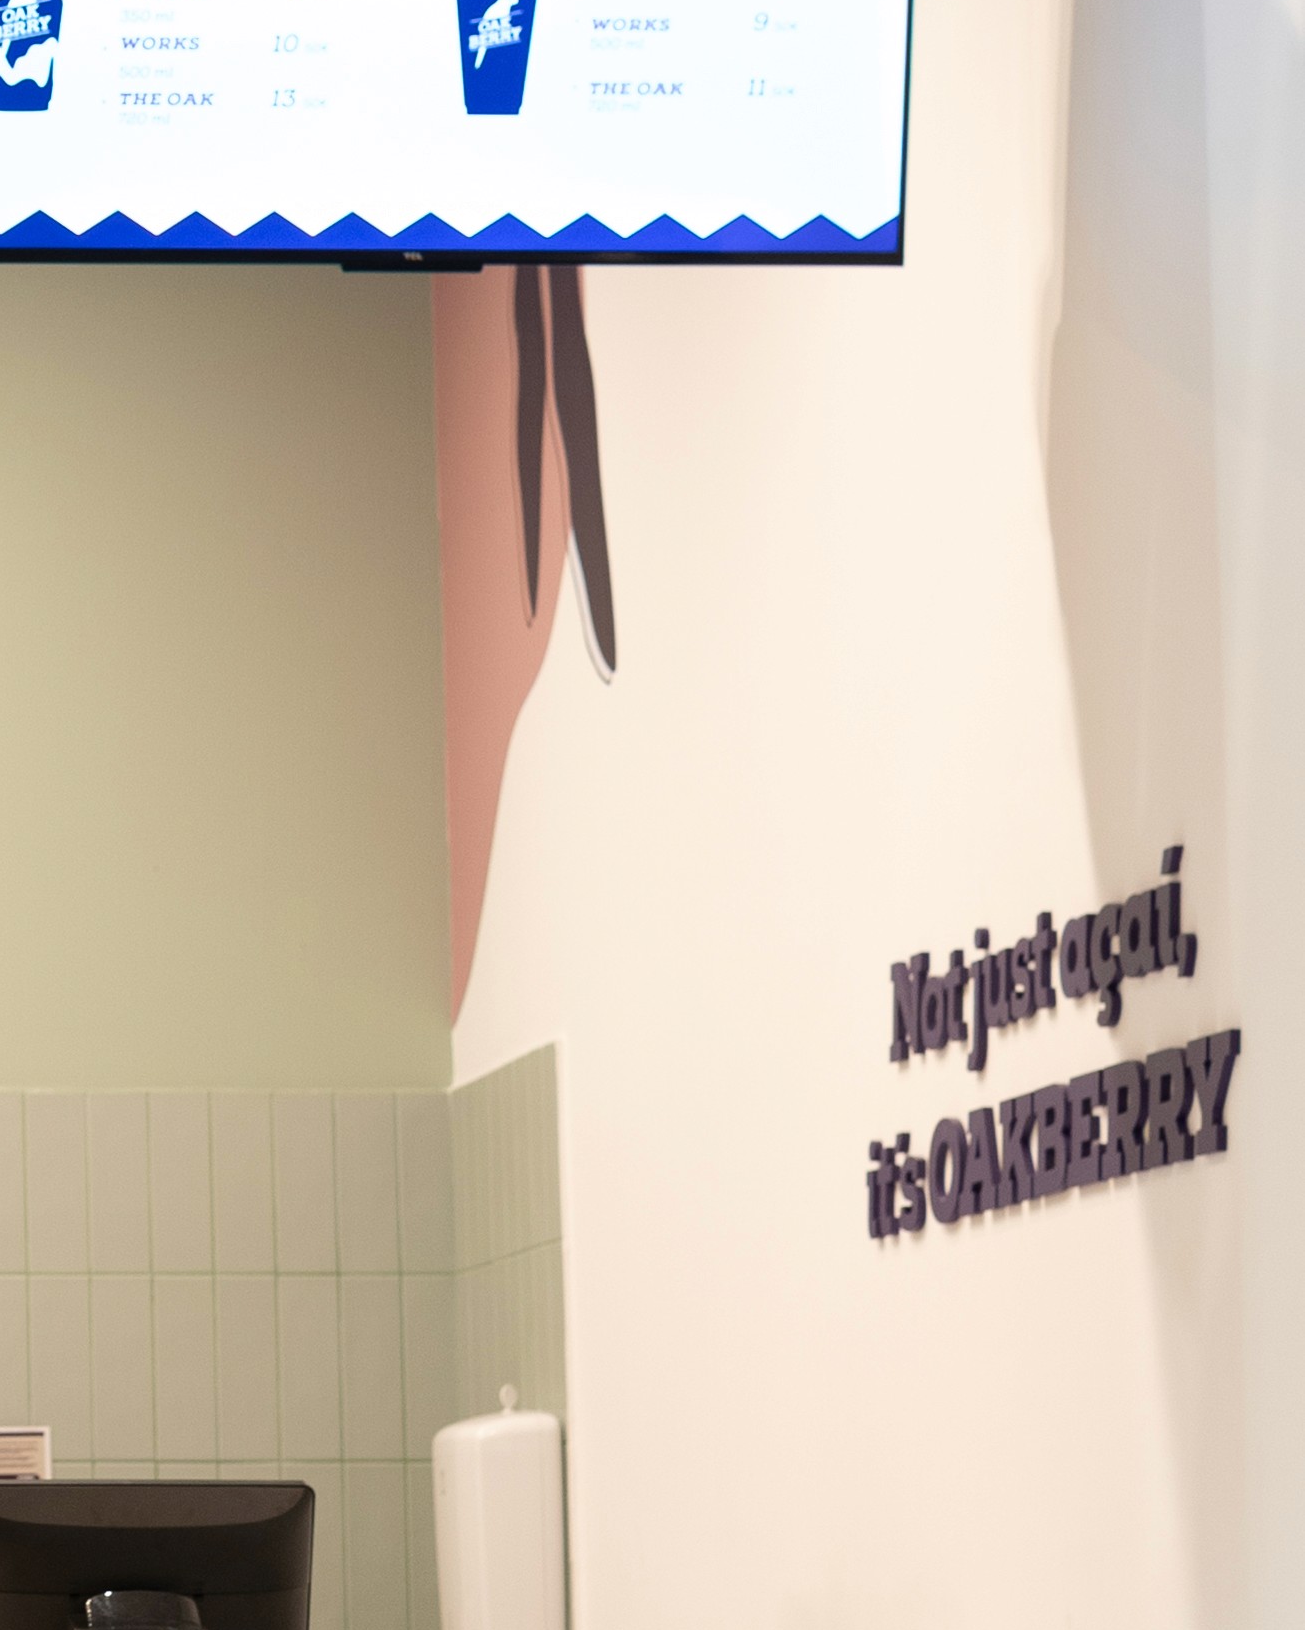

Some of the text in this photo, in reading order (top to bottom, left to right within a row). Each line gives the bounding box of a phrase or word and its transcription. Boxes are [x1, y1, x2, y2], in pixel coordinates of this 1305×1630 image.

[2, 3, 39, 24] OAK
[592, 17, 671, 32] WORKS
[121, 35, 200, 51] WORKS
[272, 33, 301, 55] 10
[119, 92, 163, 107] THE
[166, 92, 215, 107] OAK
[271, 88, 298, 109] 13
[590, 81, 632, 96] THE
[636, 81, 685, 96] OAK
[890, 845, 1197, 1071] Not just açaí,
[867, 1029, 1241, 1239] it's OAKBERRY
